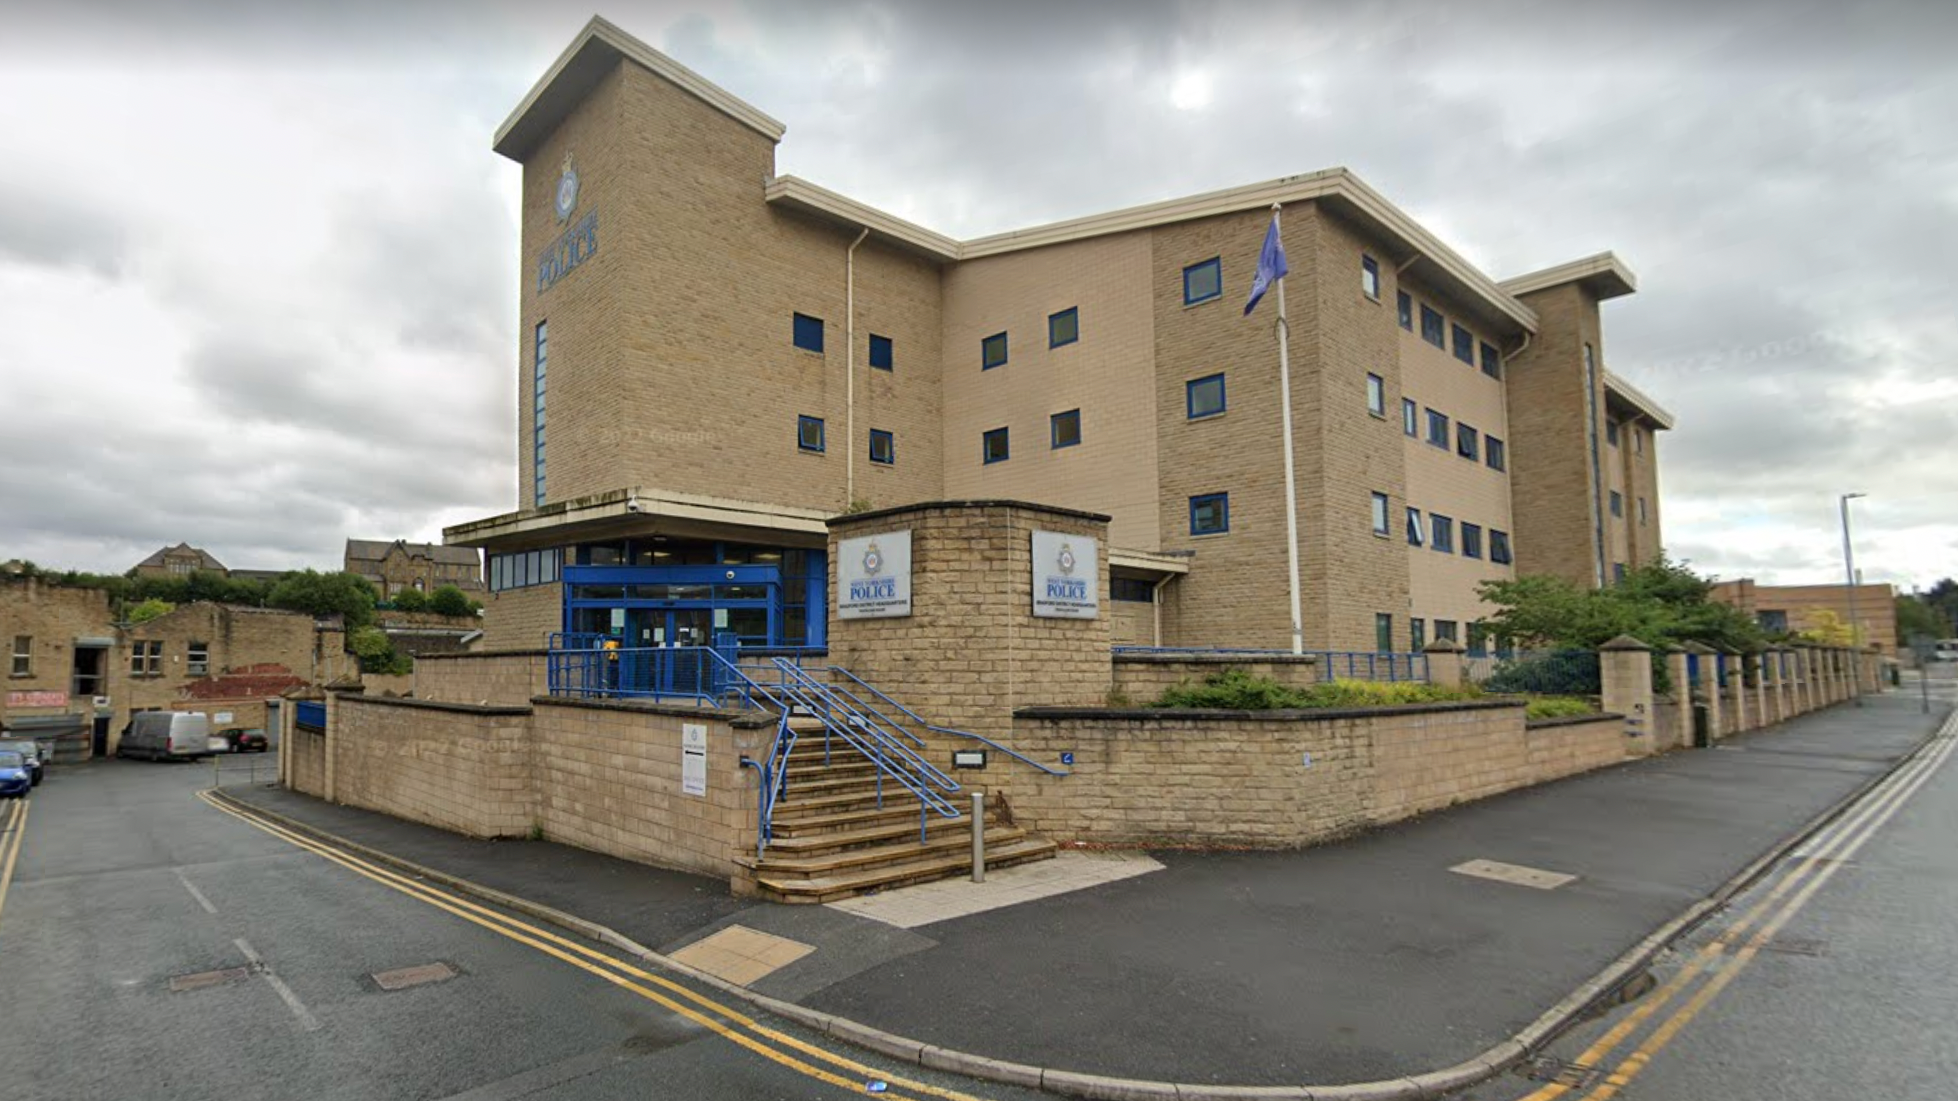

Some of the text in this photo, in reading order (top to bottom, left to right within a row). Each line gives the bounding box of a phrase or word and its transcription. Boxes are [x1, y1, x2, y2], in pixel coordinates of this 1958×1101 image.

[537, 226, 598, 294] POLICE
[850, 584, 896, 600] POLICE
[1047, 583, 1088, 600] POLICE
